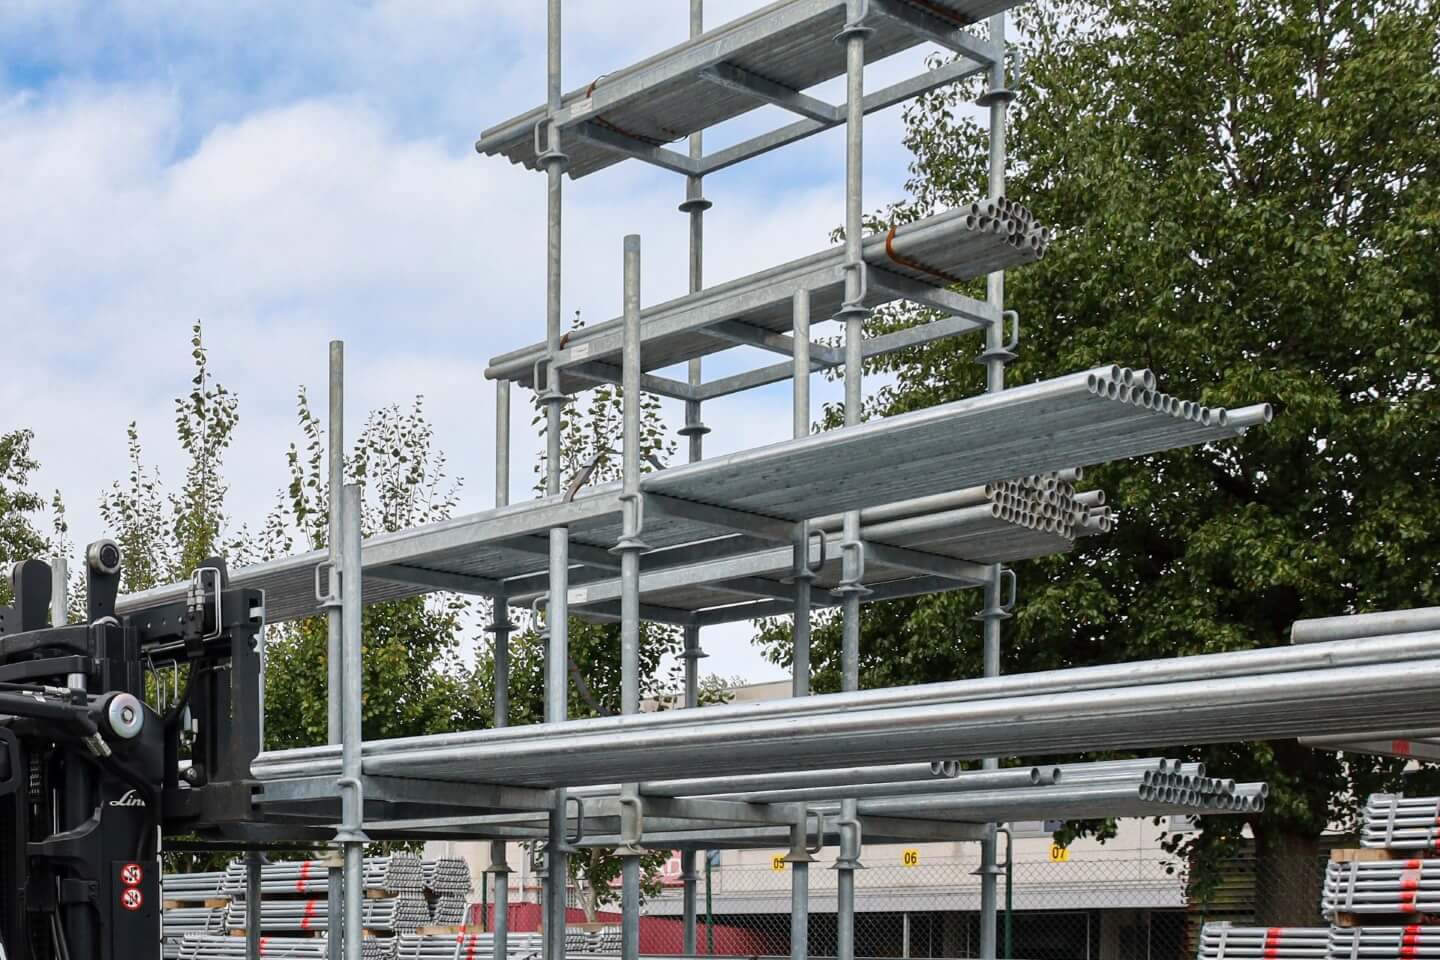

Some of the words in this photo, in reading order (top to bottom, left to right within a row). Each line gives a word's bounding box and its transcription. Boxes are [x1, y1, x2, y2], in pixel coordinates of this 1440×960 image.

[109, 789, 146, 807] Lin
[904, 852, 917, 864] 06
[1052, 846, 1065, 858] 07
